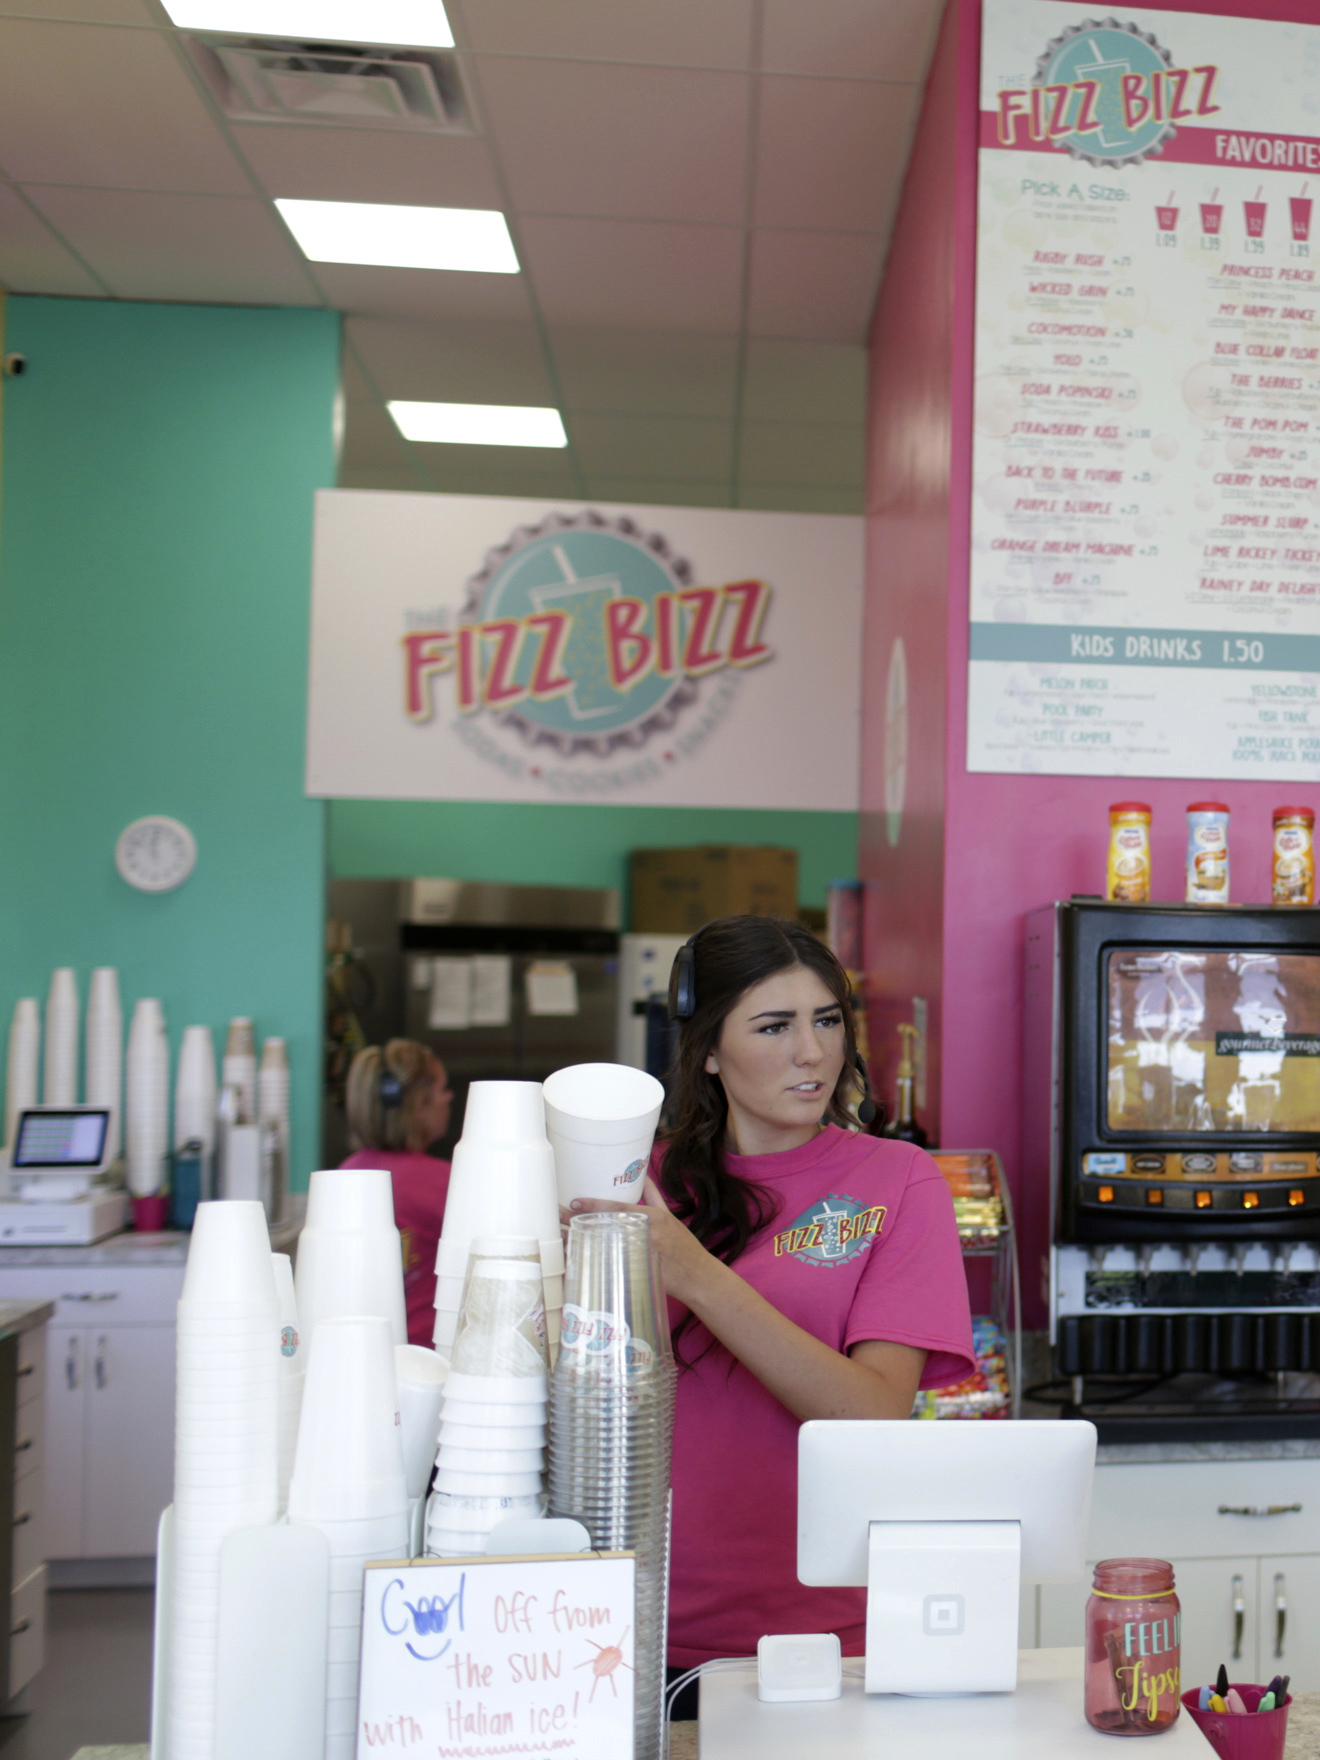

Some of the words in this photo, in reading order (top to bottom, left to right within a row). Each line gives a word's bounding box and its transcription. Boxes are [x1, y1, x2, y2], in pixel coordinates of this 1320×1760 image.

[997, 80, 1104, 145] FIZZ
[1120, 65, 1221, 132] BIZZ
[1021, 179, 1062, 197] Pick
[1067, 183, 1085, 201] A
[402, 610, 576, 722] FIZZ
[604, 578, 775, 693] BIZZ
[1071, 634, 1115, 657] KIDS
[1124, 636, 1203, 661] DRINKS
[1222, 640, 1264, 663] 1.50
[774, 1222, 826, 1256] FIZZ
[837, 1206, 888, 1246] BIZZ
[548, 1589, 612, 1633] from
[1124, 1612, 1181, 1658] FEELI
[447, 1652, 493, 1690] the
[508, 1649, 562, 1683] SUN
[364, 1714, 423, 1748] with
[530, 1691, 580, 1735] ice!
